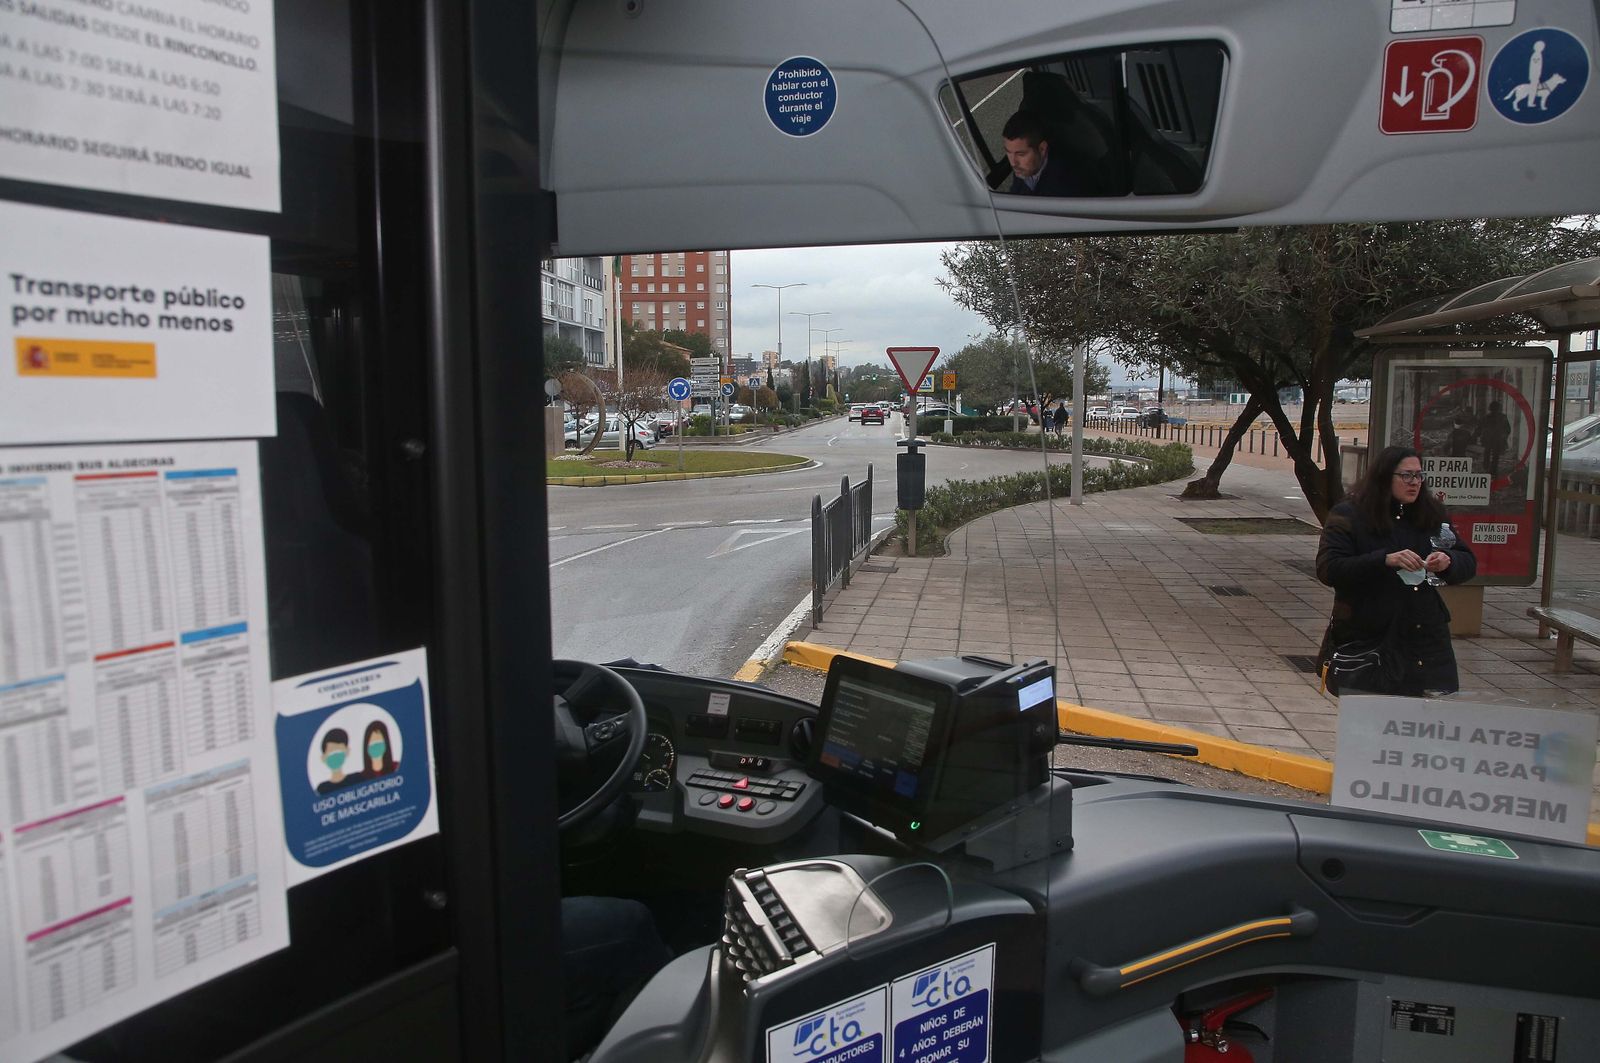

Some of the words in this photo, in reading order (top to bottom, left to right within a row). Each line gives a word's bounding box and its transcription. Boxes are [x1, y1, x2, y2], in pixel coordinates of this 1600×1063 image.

[20, 1, 89, 32] SALIDAS
[91, 18, 141, 44] DESDE
[144, 31, 161, 49] EL
[117, 1, 177, 27] CAMBIA
[180, 17, 195, 33] EL
[198, 21, 260, 50] HORARIO
[17, 37, 29, 53] A
[32, 40, 65, 62] LAS
[148, 68, 160, 82] A
[161, 70, 188, 90] LAS
[778, 68, 822, 79] Prohibido
[18, 65, 32, 81] A
[34, 69, 67, 91] LAS
[149, 94, 161, 107] A
[162, 97, 188, 115] LAS
[771, 81, 800, 91] hablar
[801, 81, 818, 89] con
[820, 78, 829, 87] el
[778, 91, 823, 101] conductor
[779, 103, 812, 113] durante
[814, 101, 823, 110] el
[790, 113, 812, 124] viaje
[153, 150, 207, 173] SIENDO
[9, 273, 156, 304] Transporte
[163, 285, 245, 310] público
[12, 304, 58, 327] por
[66, 306, 151, 328] mucho
[158, 314, 234, 332] menos
[77, 458, 103, 471] BUS
[107, 455, 175, 470] ALGECIRAS
[1438, 460, 1469, 472] PARA
[1424, 476, 1488, 488] OBREVIVIR
[1474, 523, 1495, 533] ENVÍA
[1496, 524, 1516, 533] SIRIA
[312, 796, 337, 813] USO
[336, 775, 404, 805] OBLIGATORIO
[320, 810, 337, 827] DE
[337, 791, 401, 820] MASCARILLA
[912, 970, 972, 1008] cta
[920, 1014, 947, 1034] NIÑOS
[953, 1006, 966, 1020] DE
[793, 1016, 864, 1056] cta
[899, 1048, 905, 1058] 4
[911, 1035, 937, 1054] AÑOS
[943, 1015, 984, 1040] DEBERÁN
[957, 1037, 970, 1050] SU
